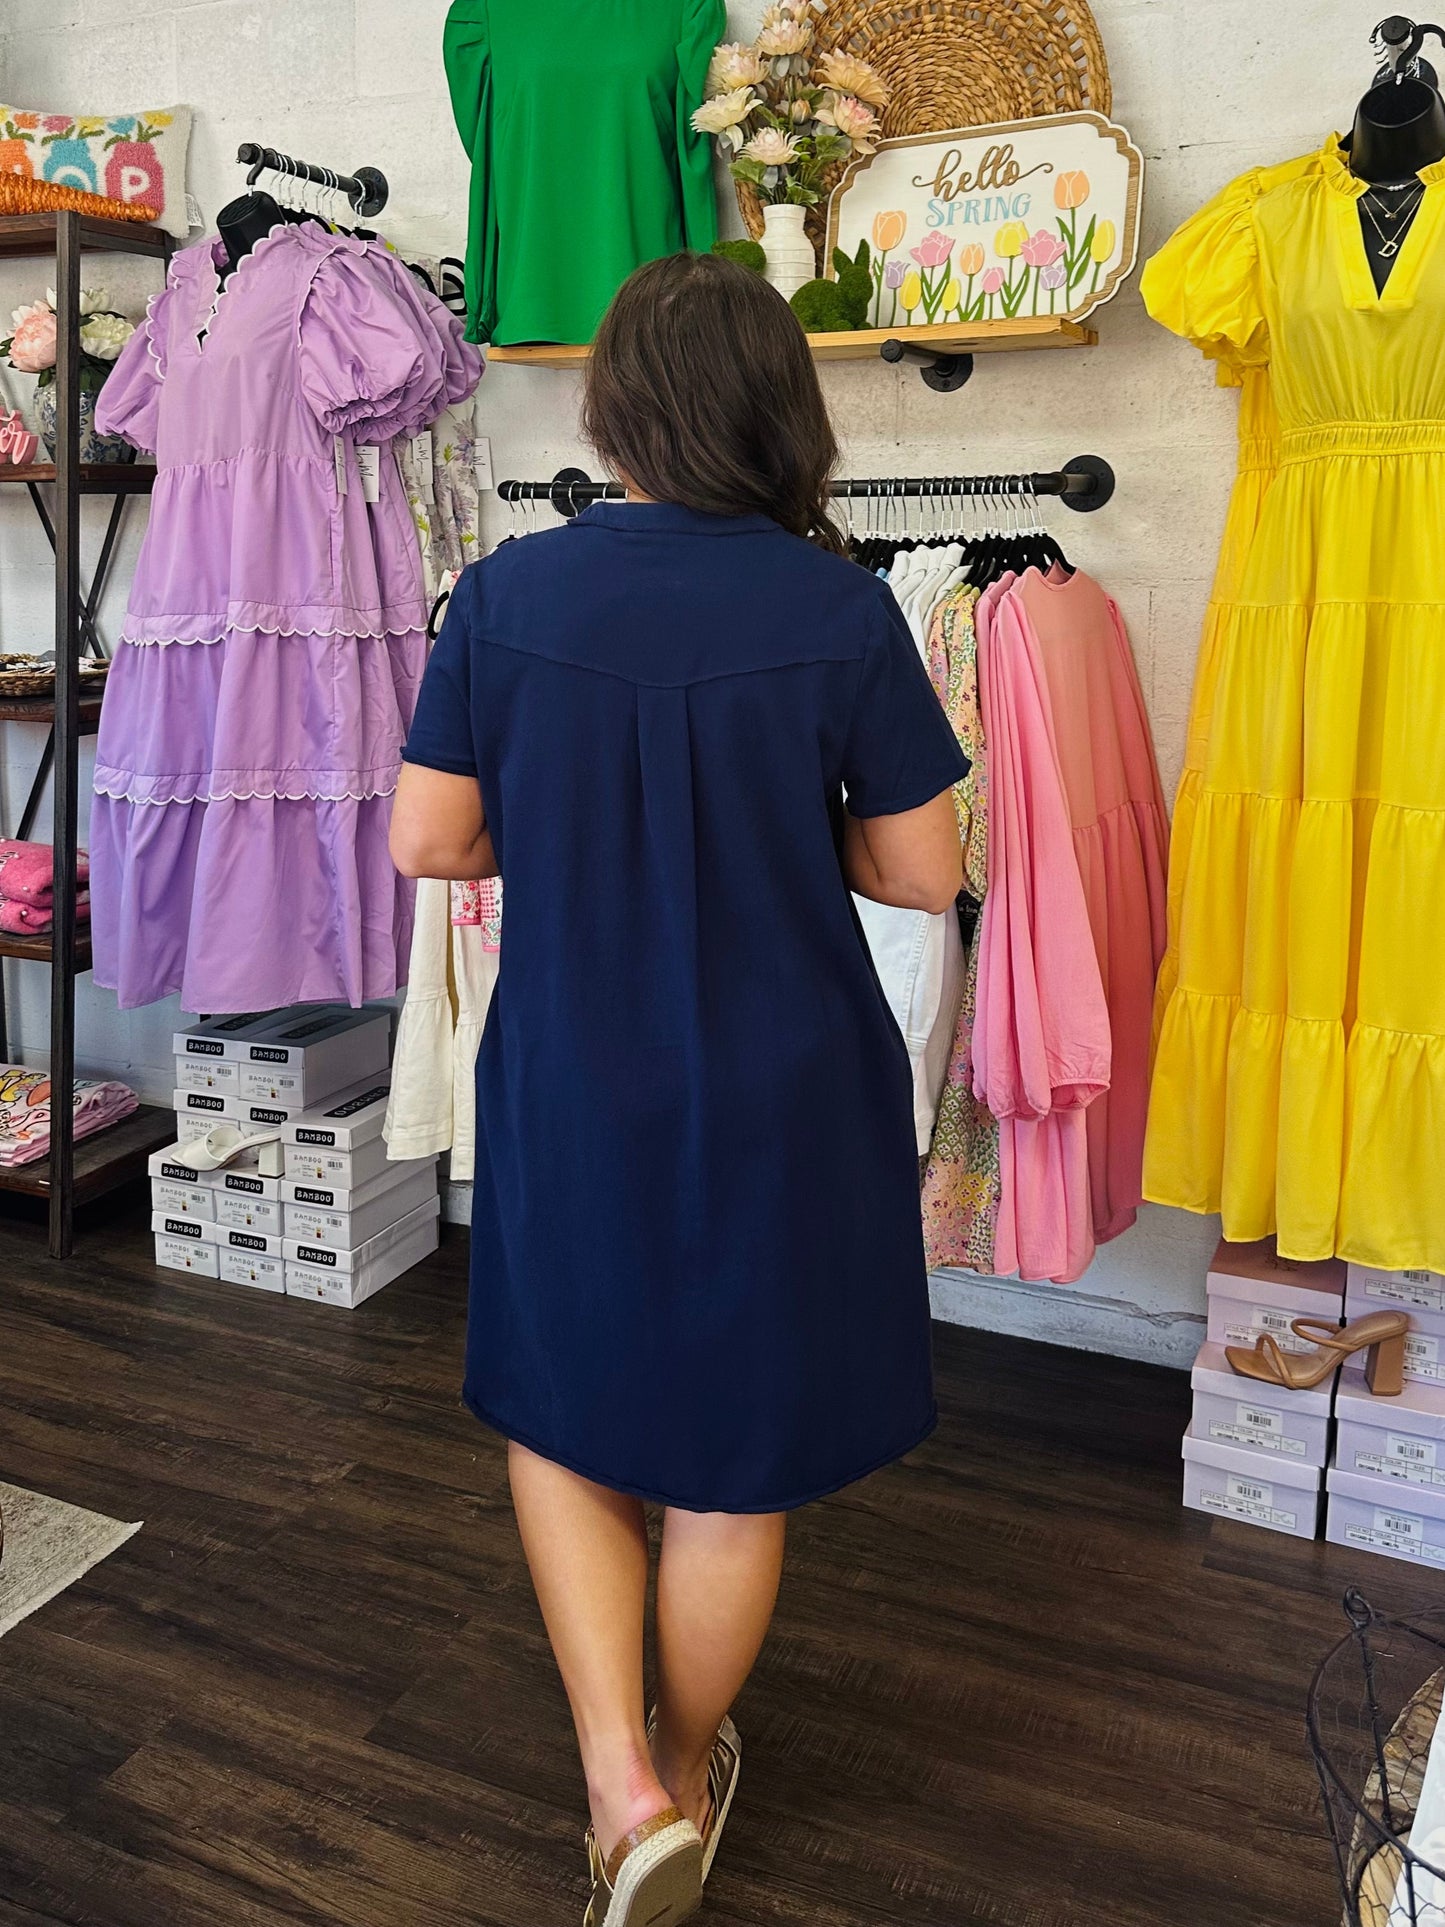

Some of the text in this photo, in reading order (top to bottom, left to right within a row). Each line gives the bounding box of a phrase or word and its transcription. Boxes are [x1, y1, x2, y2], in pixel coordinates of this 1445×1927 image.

[912, 143, 1054, 202] hello
[925, 192, 1032, 228] SPRING
[188, 1041, 222, 1054] BAMBOO
[252, 1049, 286, 1061] BAMBOO
[189, 1097, 222, 1109] BAMBOO
[251, 1110, 286, 1122] BAMBOO
[298, 1131, 333, 1143] BAMBOO
[163, 1166, 196, 1179] BAMBOO
[227, 1178, 261, 1191] BAMBOO
[296, 1190, 332, 1203] BAMBOO
[167, 1221, 200, 1235] BAMBOO
[231, 1235, 265, 1249] BAMBOO
[299, 1249, 334, 1263] BAMBOO
